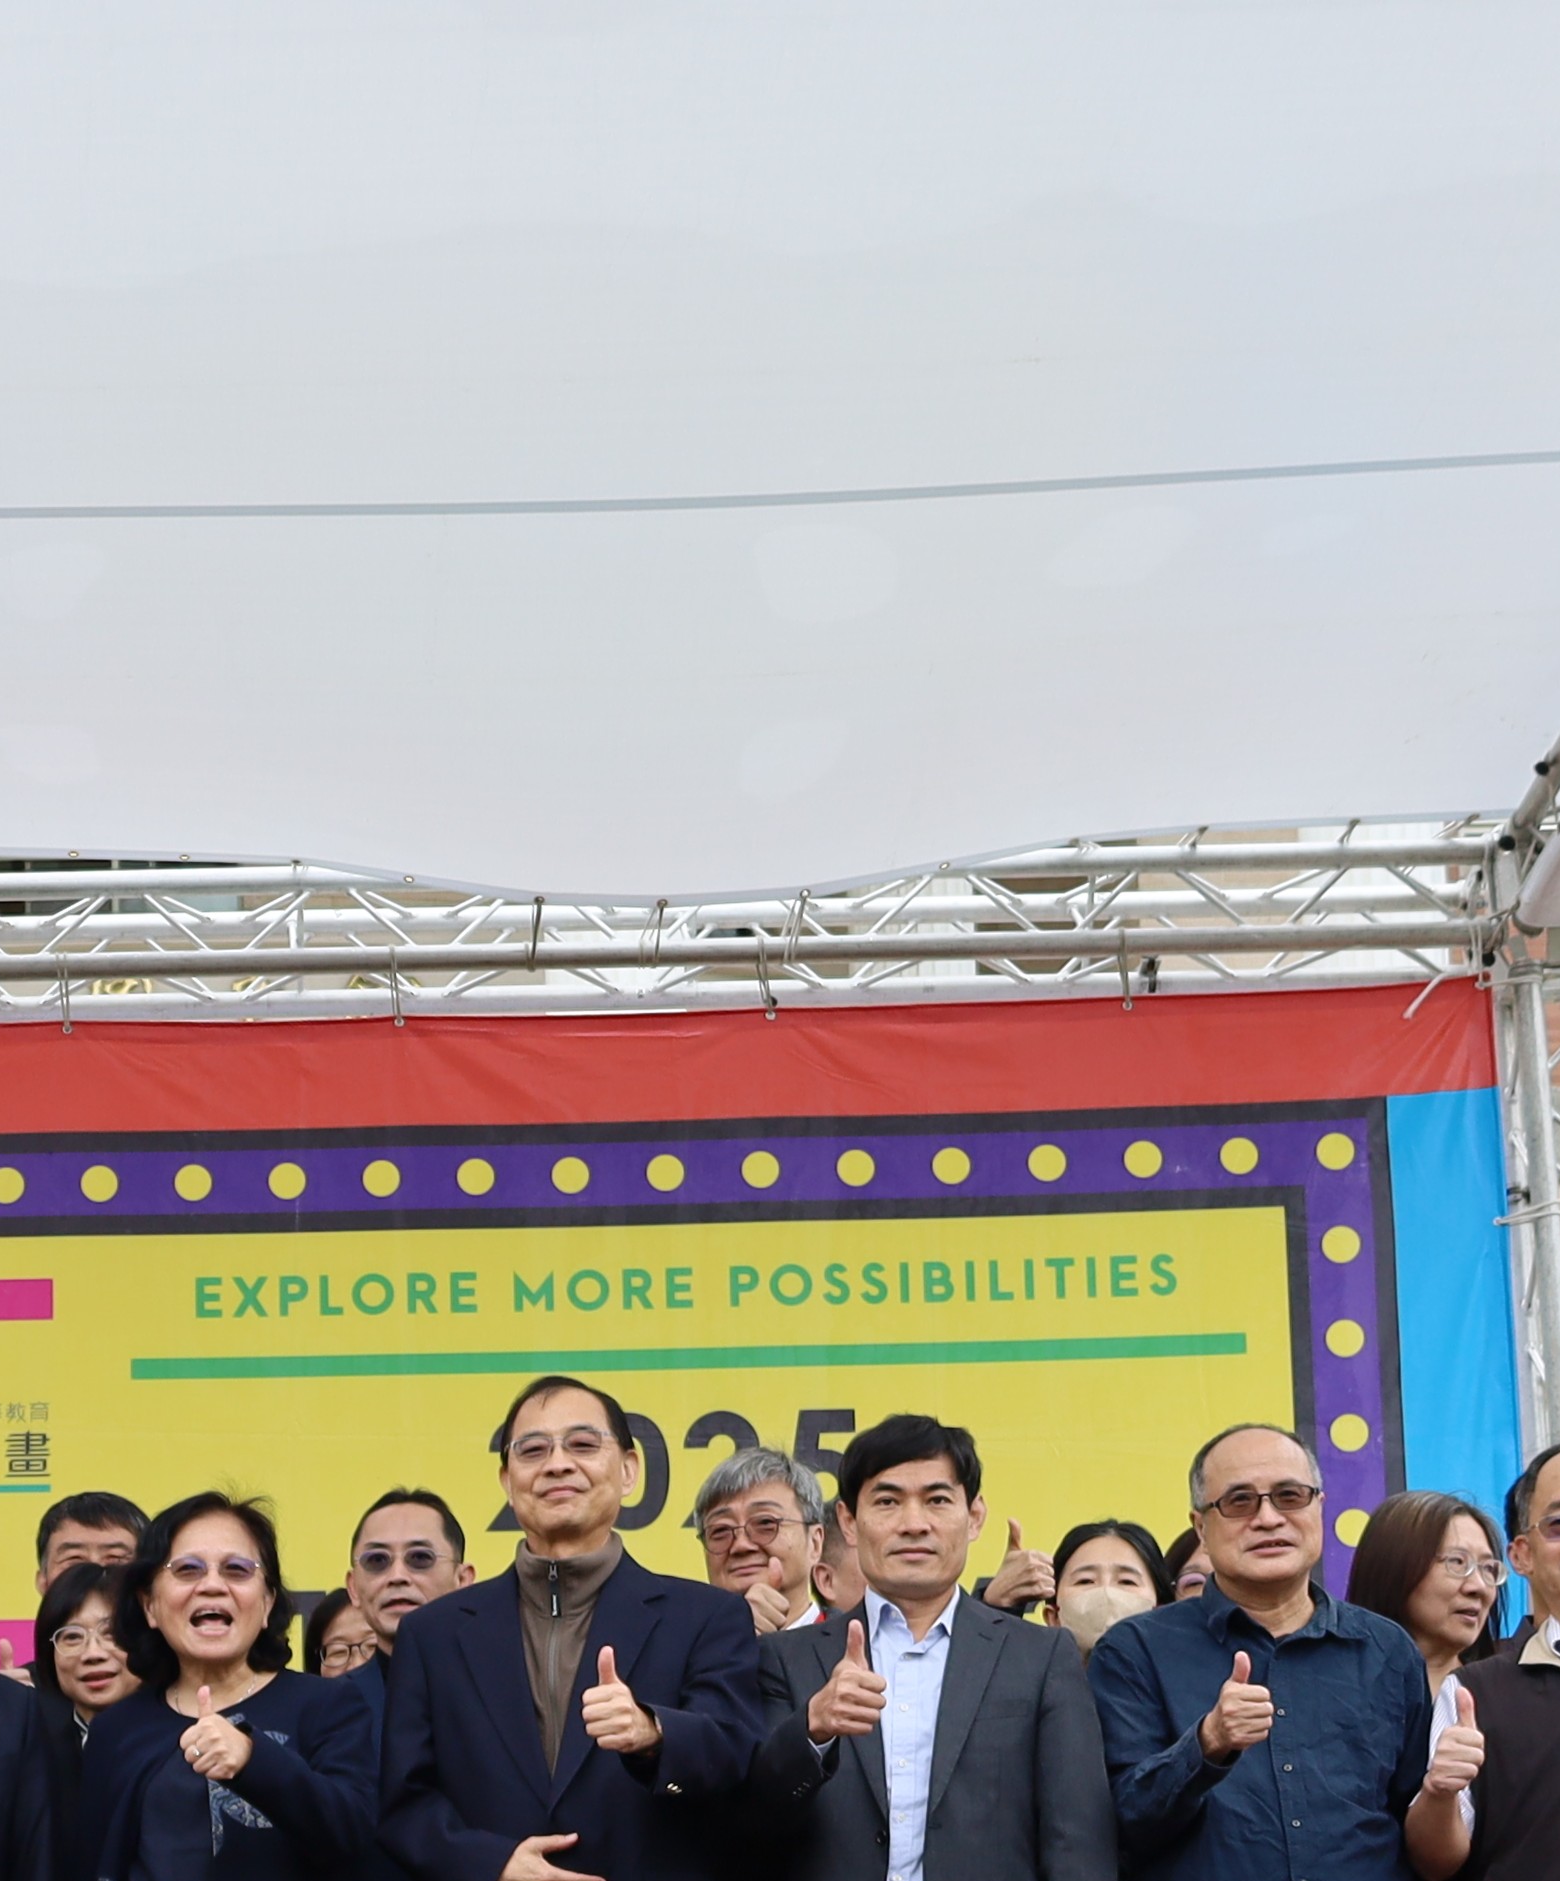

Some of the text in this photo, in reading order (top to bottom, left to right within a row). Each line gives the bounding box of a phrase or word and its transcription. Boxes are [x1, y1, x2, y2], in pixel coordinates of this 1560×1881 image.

[196, 1254, 1178, 1318] EXPLORE MORE POSSIBILITIES
